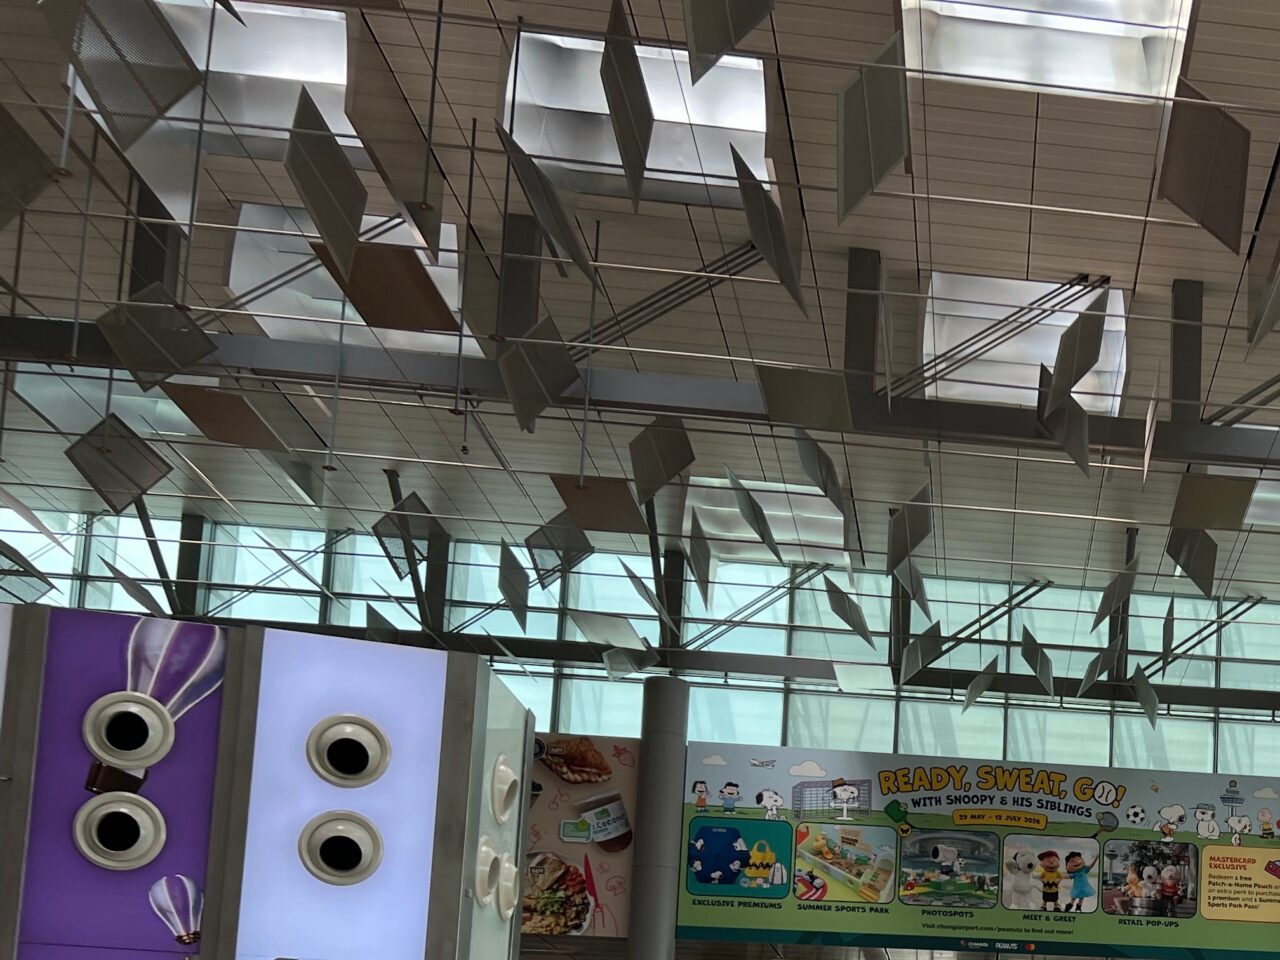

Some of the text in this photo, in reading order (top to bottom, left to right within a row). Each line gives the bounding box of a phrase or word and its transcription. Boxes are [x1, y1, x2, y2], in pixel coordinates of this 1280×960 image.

[878, 766, 971, 796] READY,
[976, 766, 1067, 798] SWEAT,
[911, 794, 1092, 818] WITH SNOOPY & HIS SIBLINGS
[1209, 856, 1256, 864] MASTERCARD
[692, 899, 783, 910] EXCLUSIVE PREMIUMS
[797, 903, 890, 914] SUMMER SPORTS PARK
[921, 909, 975, 918] PHOTOSPOTS
[1053, 915, 1077, 923] GREET
[1118, 918, 1179, 928] RETAIL POP-UPS
[921, 922, 935, 930] Visit
